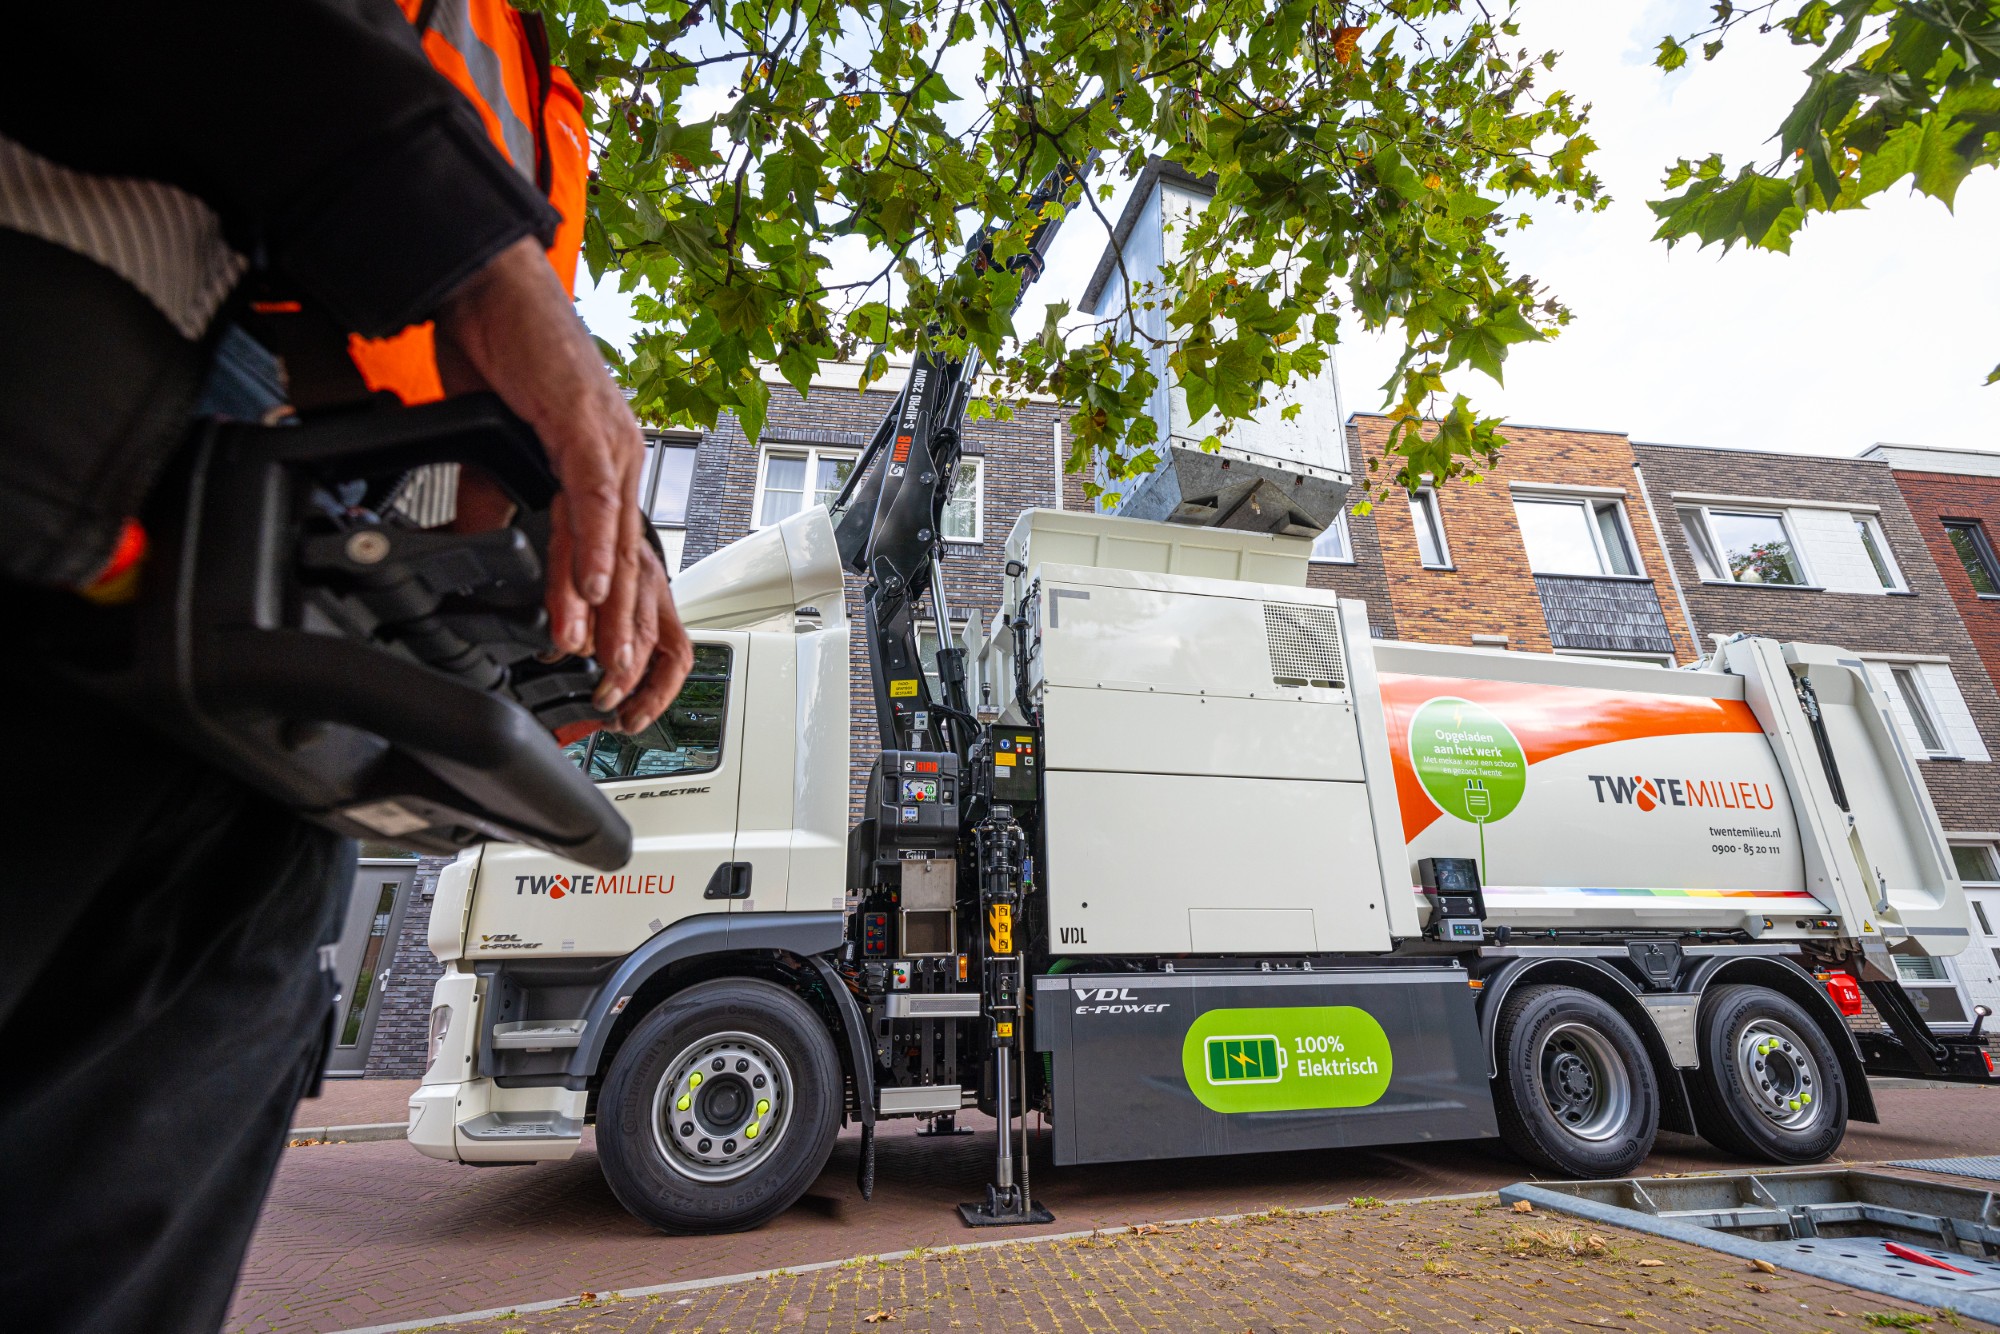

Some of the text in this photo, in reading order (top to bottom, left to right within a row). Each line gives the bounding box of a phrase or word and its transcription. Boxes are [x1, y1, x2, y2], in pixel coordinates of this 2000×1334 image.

[903, 368, 928, 429] S-HIPRO 230W
[892, 435, 912, 462] HIAB
[1435, 730, 1494, 744] Opgeladen
[1434, 744, 1503, 758] aan het werk
[916, 761, 938, 773] HIAB
[1423, 756, 1439, 764] Met
[1439, 757, 1463, 765] mekaar
[1494, 760, 1518, 768] schoon
[1453, 767, 1477, 776] gezond
[1478, 768, 1503, 777] Twente
[614, 786, 711, 801] CF ELECTRIC
[1709, 826, 1781, 838] twentemilieu.nl
[1712, 844, 1736, 855] 0900
[1743, 843, 1754, 856] 85
[1756, 846, 1767, 854] 20
[1768, 847, 1780, 855] 111
[482, 934, 523, 942] VDL
[1060, 927, 1088, 944] VDL
[1074, 988, 1140, 1001] VDL
[1294, 1035, 1345, 1054] 100%
[1524, 1010, 1550, 1070] EfficientPro
[1724, 1022, 1738, 1060] EcoPlus
[1297, 1056, 1379, 1077] Elektrisch
[1727, 1064, 1741, 1095] Conti
[1524, 1073, 1539, 1106] Conti
